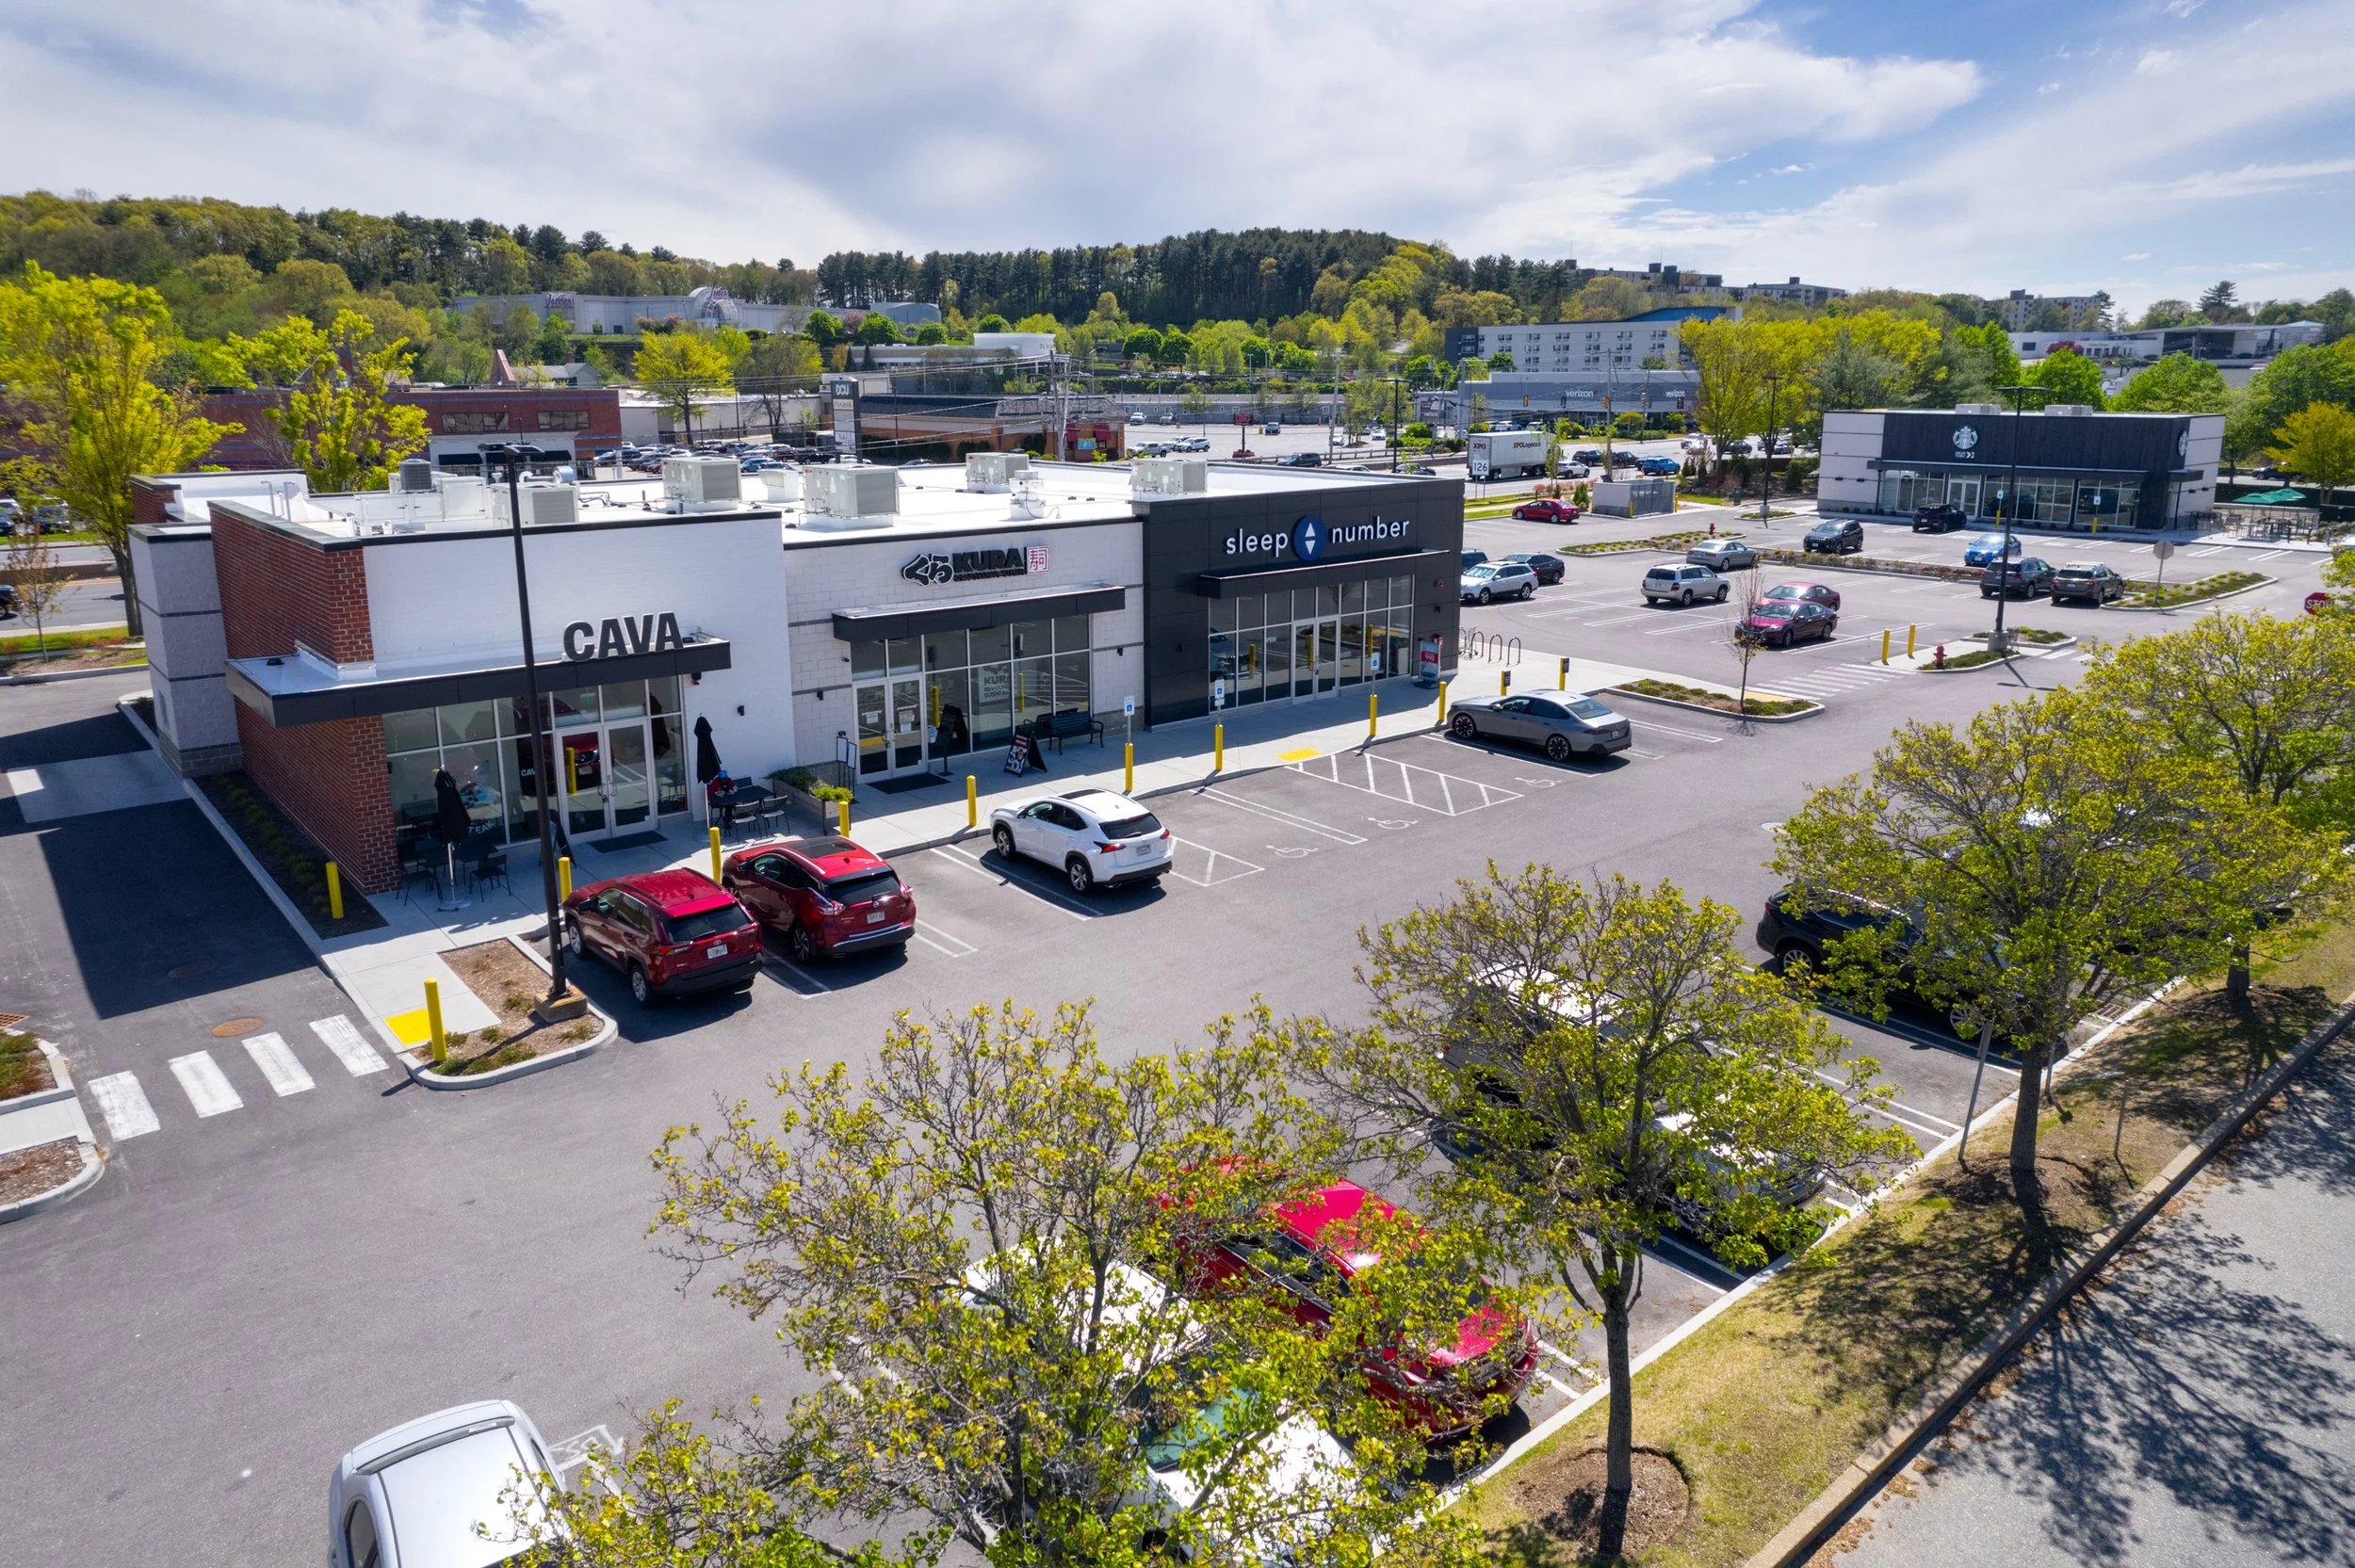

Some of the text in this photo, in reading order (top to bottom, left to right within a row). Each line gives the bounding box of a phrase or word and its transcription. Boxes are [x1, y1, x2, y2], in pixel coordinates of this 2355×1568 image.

[836, 383, 850, 396] DCU
[1566, 389, 1594, 397] verizon
[1473, 462, 1488, 472] 126
[1226, 516, 1410, 558] sleep number
[951, 548, 1025, 573] KURA
[563, 610, 684, 663] CAVA
[521, 768, 536, 777] CAV
[468, 822, 495, 834] TEAK
